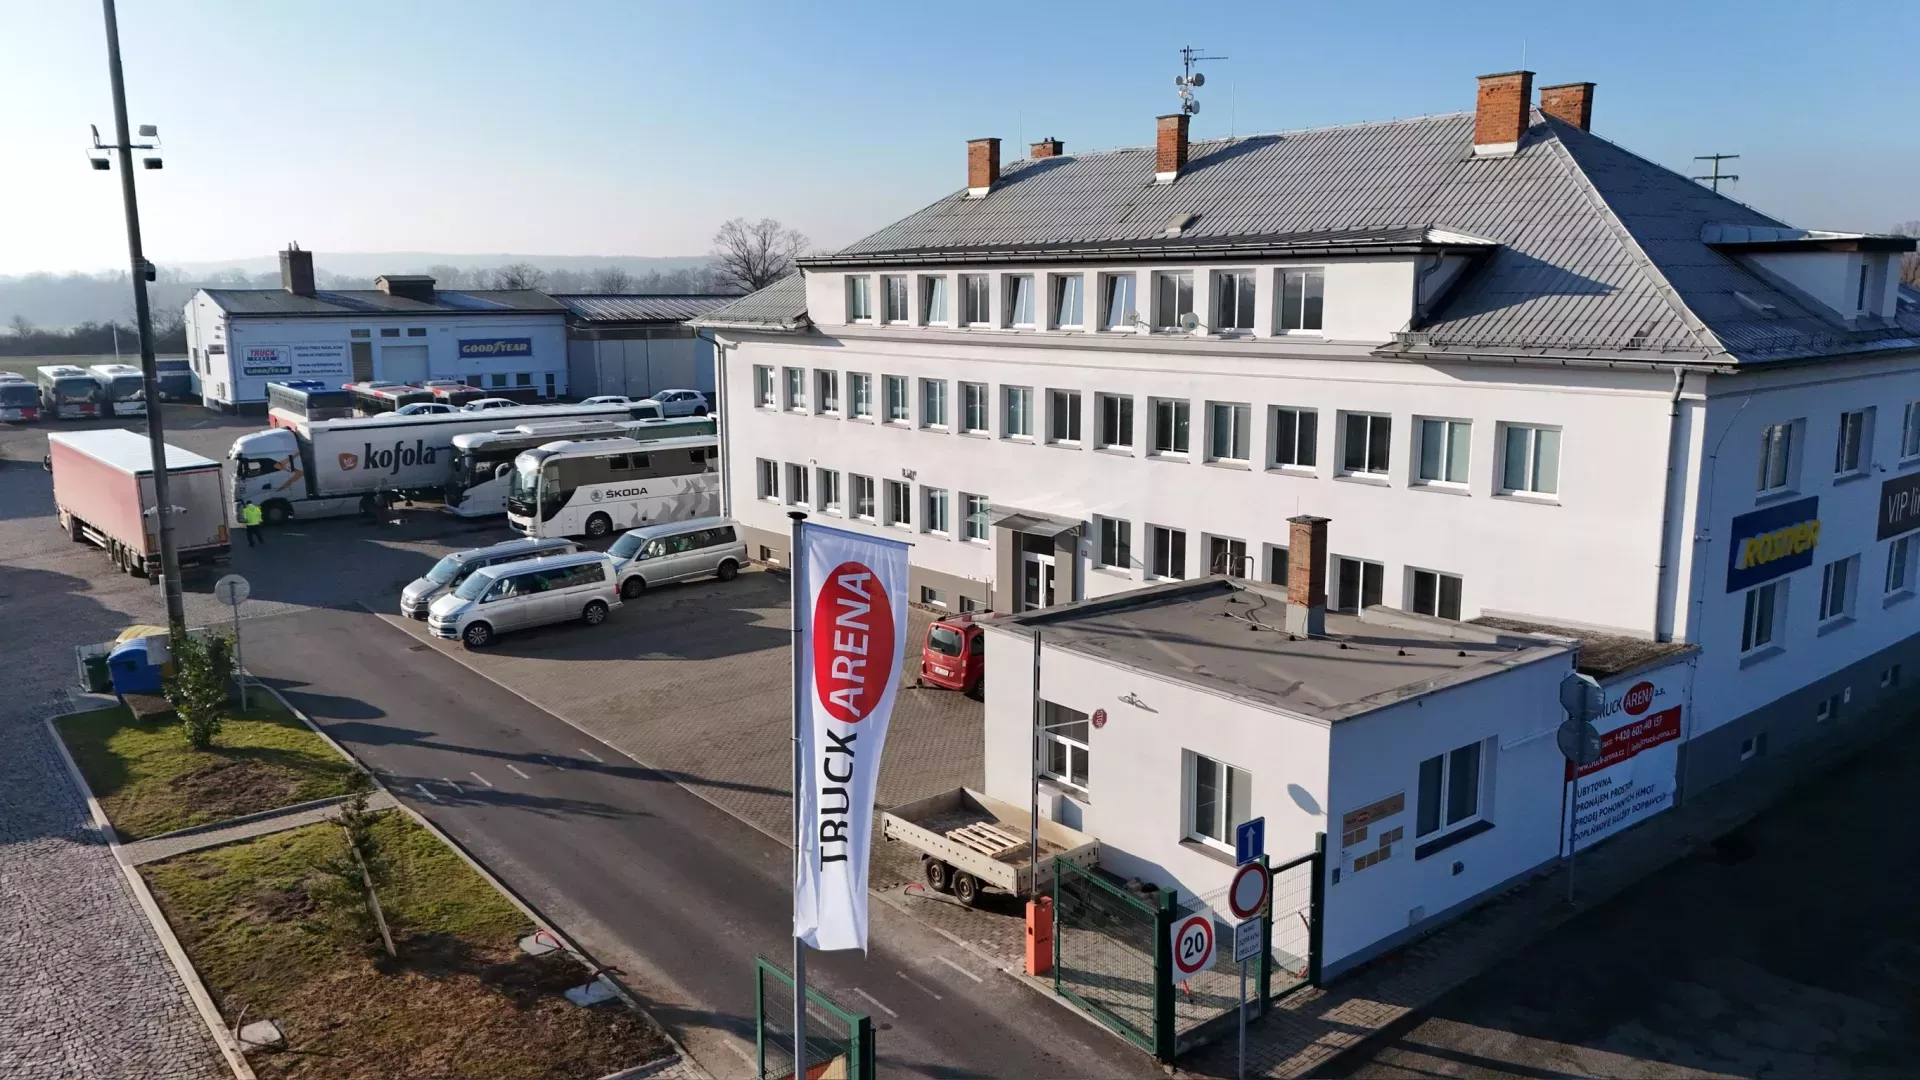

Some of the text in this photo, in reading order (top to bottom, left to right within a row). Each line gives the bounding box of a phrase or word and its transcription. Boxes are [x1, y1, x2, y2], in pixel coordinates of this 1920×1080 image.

[250, 348, 275, 357] TRUCK
[462, 341, 528, 354] GOODYEAR
[363, 439, 436, 475] kofola
[605, 487, 648, 499] ŠKODA
[1888, 491, 1908, 524] VIP
[1596, 696, 1622, 720] RUCK
[1625, 687, 1653, 709] ARENA
[819, 572, 873, 872] TRUCK ARENA
[1096, 710, 1104, 727] STOP
[1577, 776, 1612, 798] UBYTOVNA
[1183, 932, 1205, 959] 20
